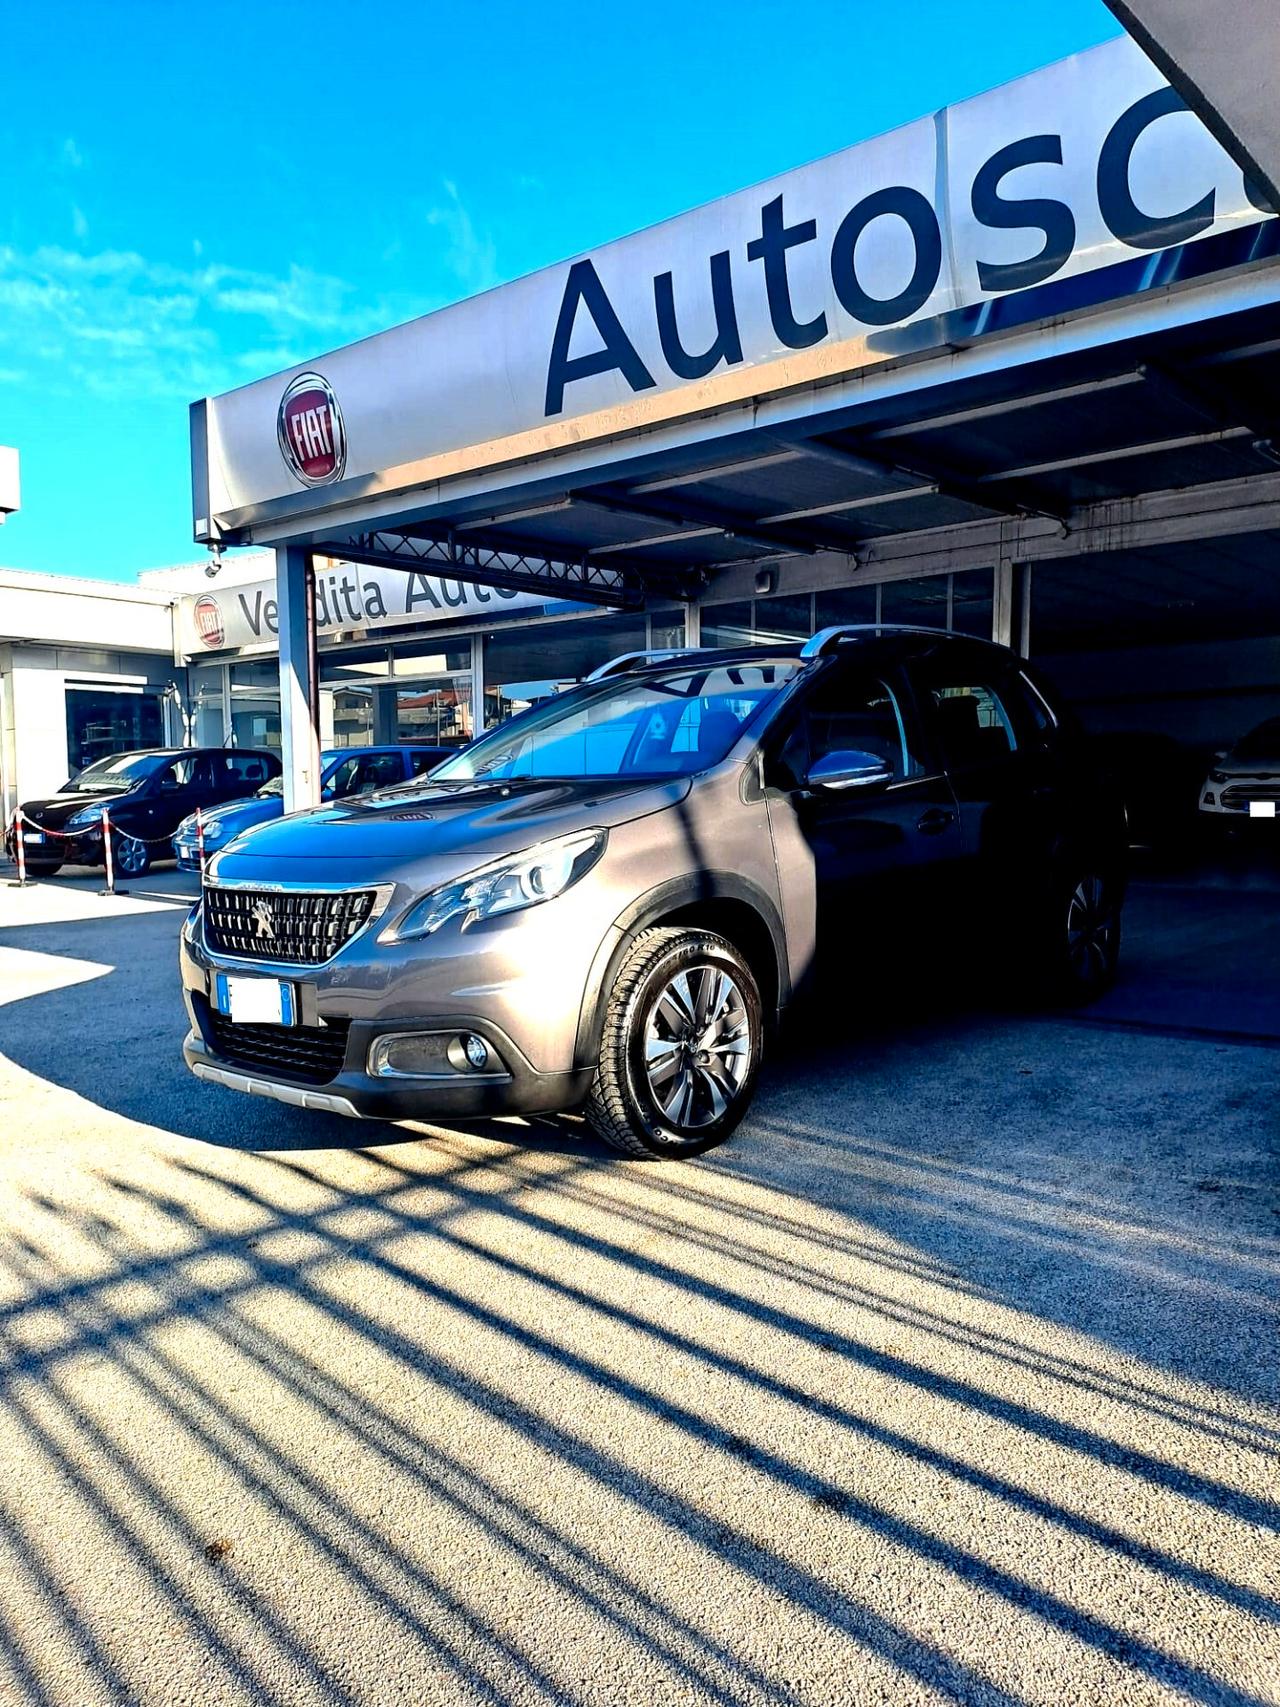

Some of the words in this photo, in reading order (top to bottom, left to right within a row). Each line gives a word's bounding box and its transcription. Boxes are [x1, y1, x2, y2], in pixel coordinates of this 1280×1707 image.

[545, 84, 1280, 416] Autosc
[291, 405, 332, 462] FIAT
[238, 576, 388, 636] Vedita
